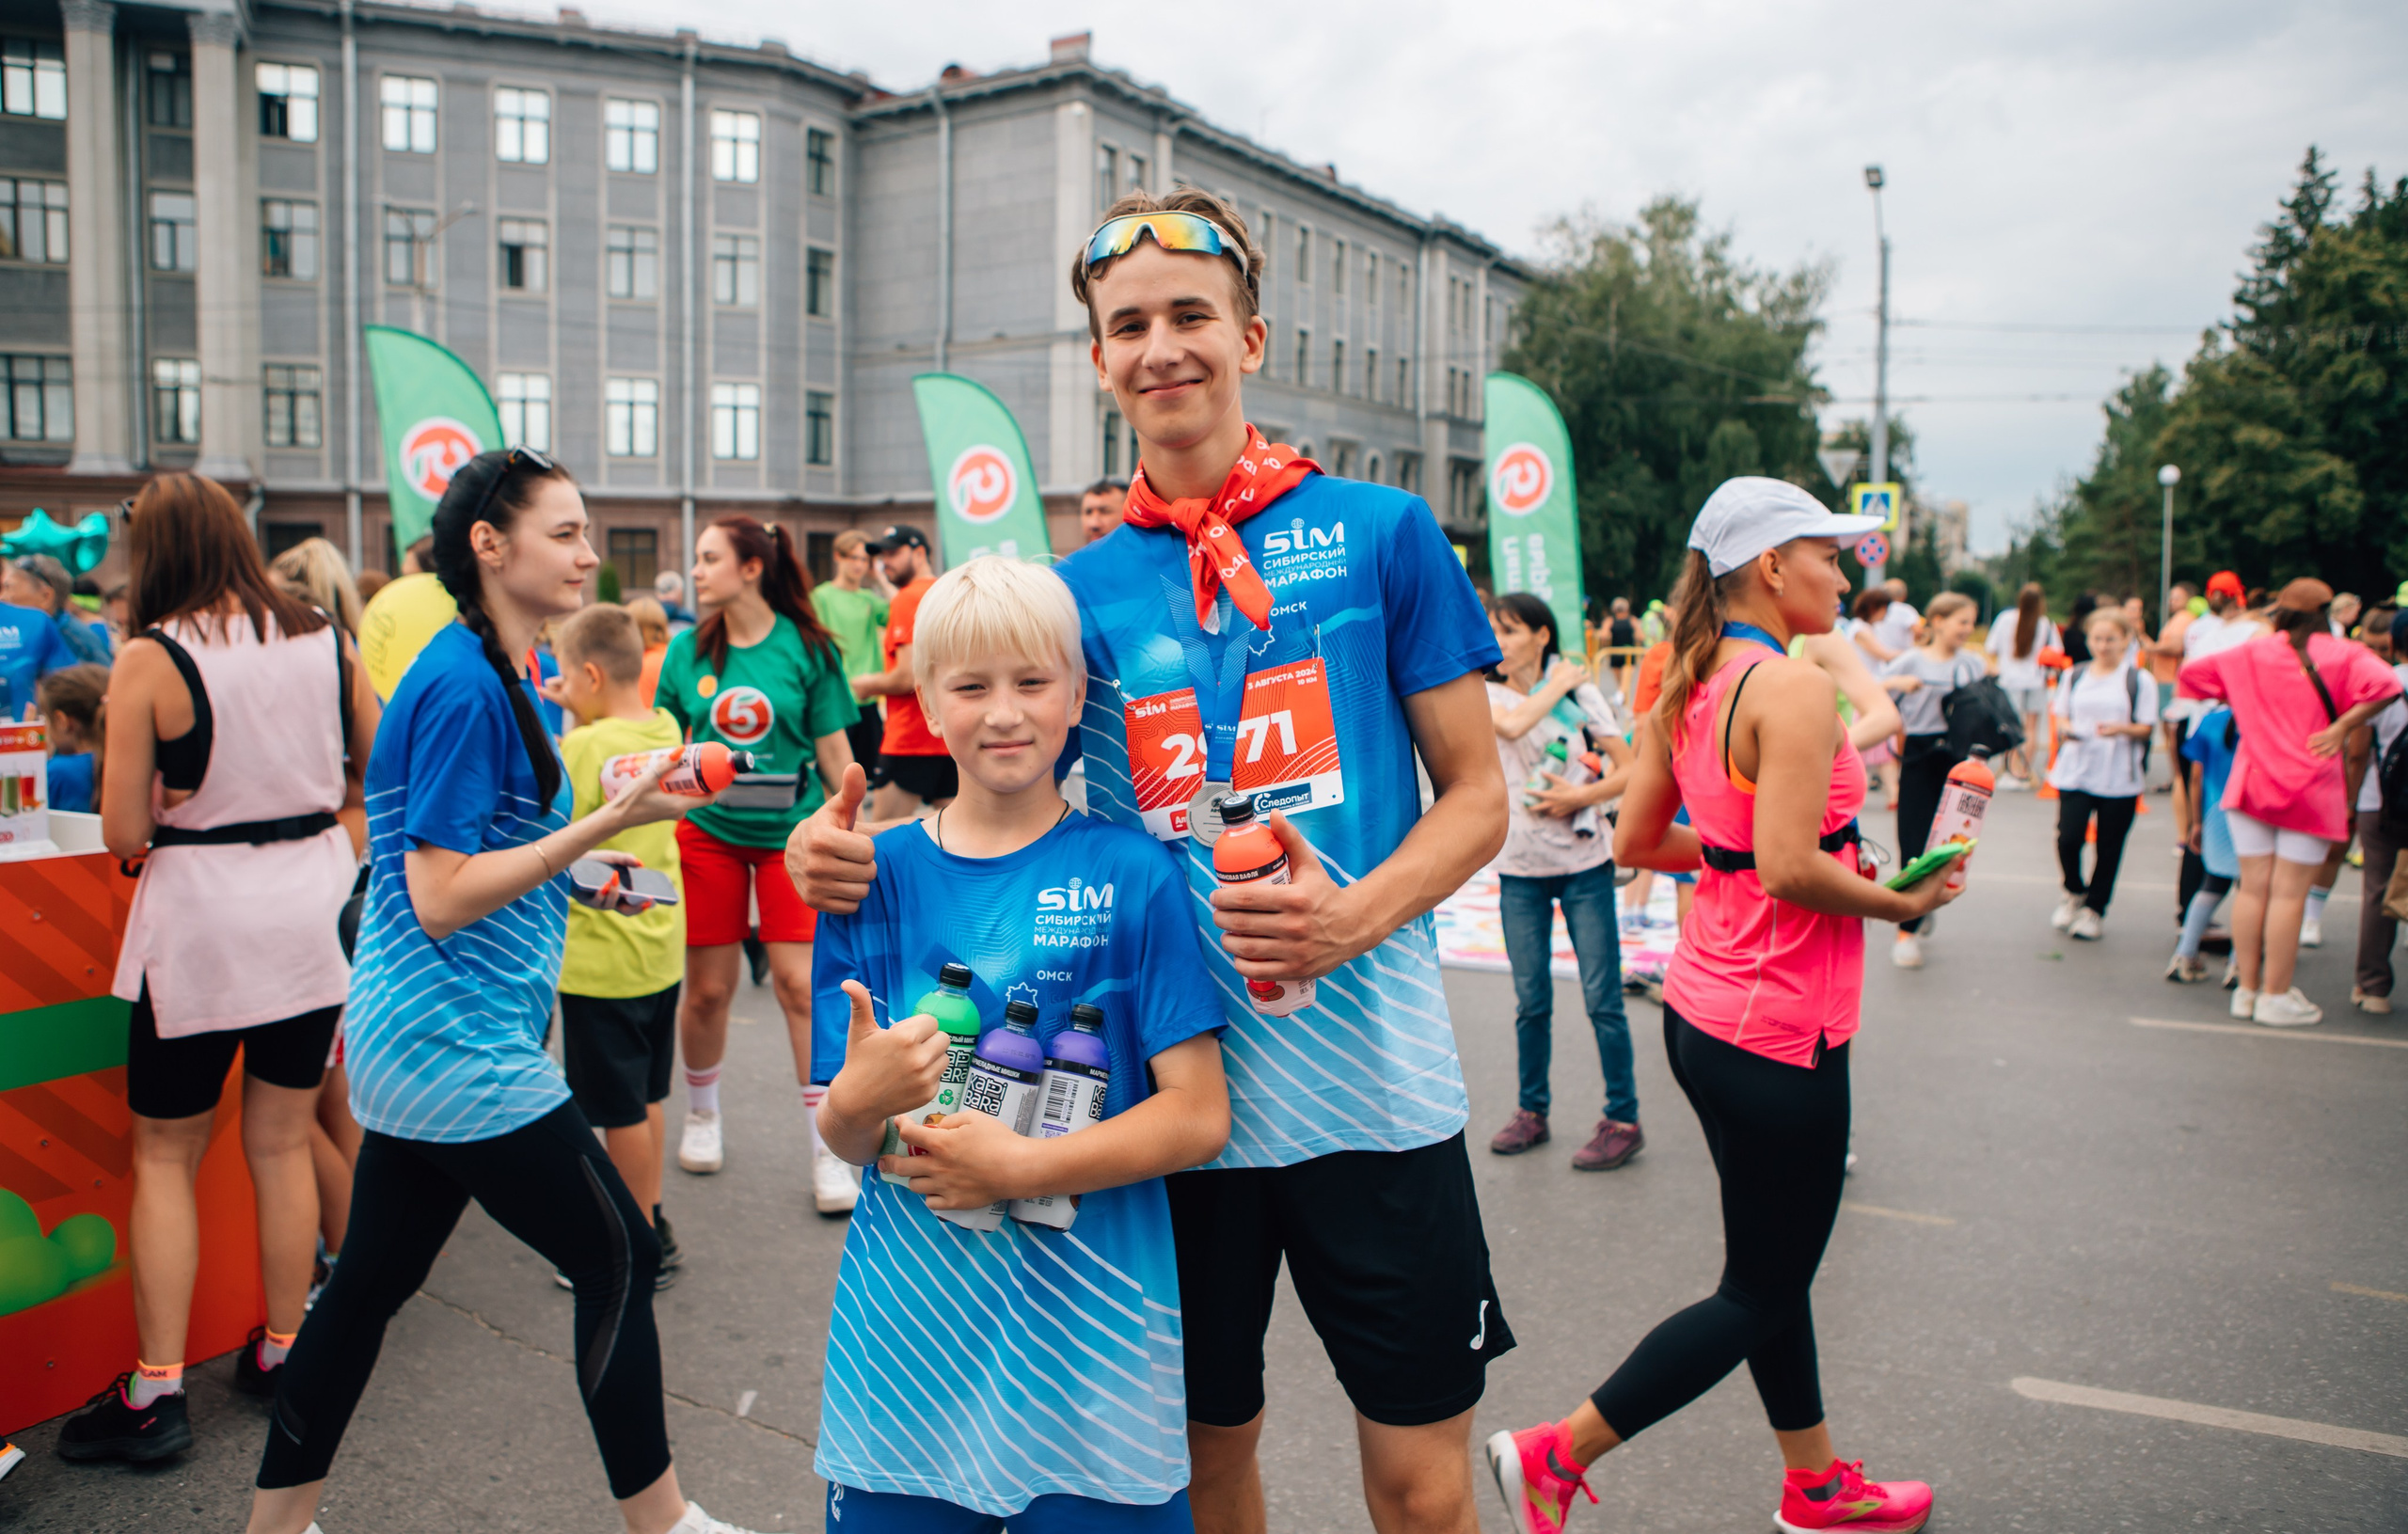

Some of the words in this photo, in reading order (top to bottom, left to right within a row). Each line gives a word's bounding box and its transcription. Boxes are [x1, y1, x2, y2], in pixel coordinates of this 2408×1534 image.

[1263, 544, 1346, 570] СИБИРСКИЙ
[1263, 565, 1348, 590] МАРАФОН
[1271, 601, 1307, 617] ОМСК
[1247, 682, 1254, 690] 3
[1255, 672, 1294, 688] АВГУСТА
[1295, 666, 1317, 678] 2024
[1306, 676, 1318, 685] КМ
[1260, 792, 1309, 809] Следопыт
[1035, 910, 1112, 925] СИБИРСКИЙ
[1034, 934, 1109, 948] МАРАФОН
[1037, 970, 1072, 981] ОМСК
